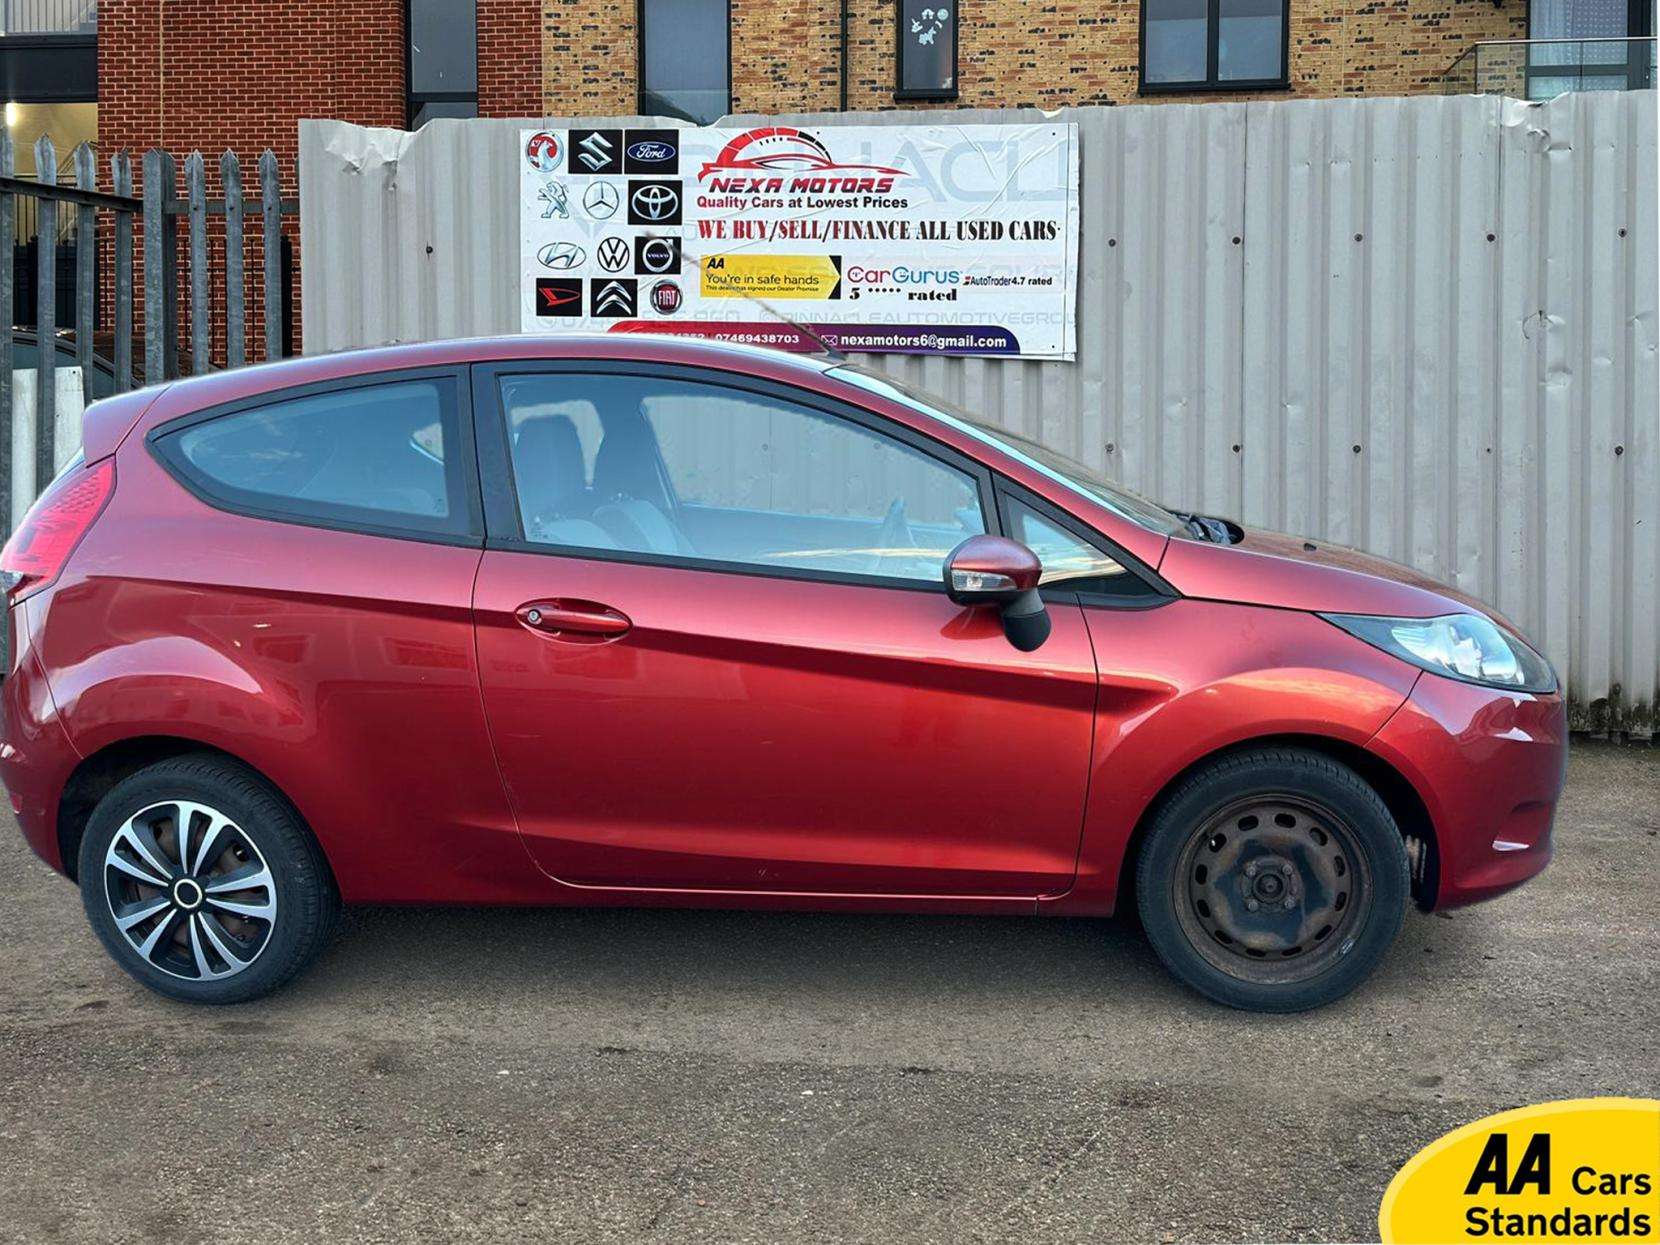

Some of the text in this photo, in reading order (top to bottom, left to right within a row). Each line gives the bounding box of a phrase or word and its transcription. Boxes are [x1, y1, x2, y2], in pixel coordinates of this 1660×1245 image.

[637, 143, 665, 158] Ford
[709, 178, 894, 193] NEXA MOTORS
[697, 196, 908, 210] Quality Cars at Lowest Prices
[697, 220, 726, 240] WE
[733, 219, 911, 243] BUY/SELL/FINANCE
[916, 220, 951, 240] ALL
[956, 220, 1003, 241] USED
[1009, 220, 1057, 241] CARS
[707, 257, 725, 269] AA
[706, 273, 819, 285] You're in safe hands
[847, 266, 960, 284] CarGurus
[1027, 276, 1052, 286] rated
[658, 290, 676, 306] FIAT
[849, 287, 958, 301] 5 rated
[840, 334, 1007, 351] nexamotors6@gmail.com
